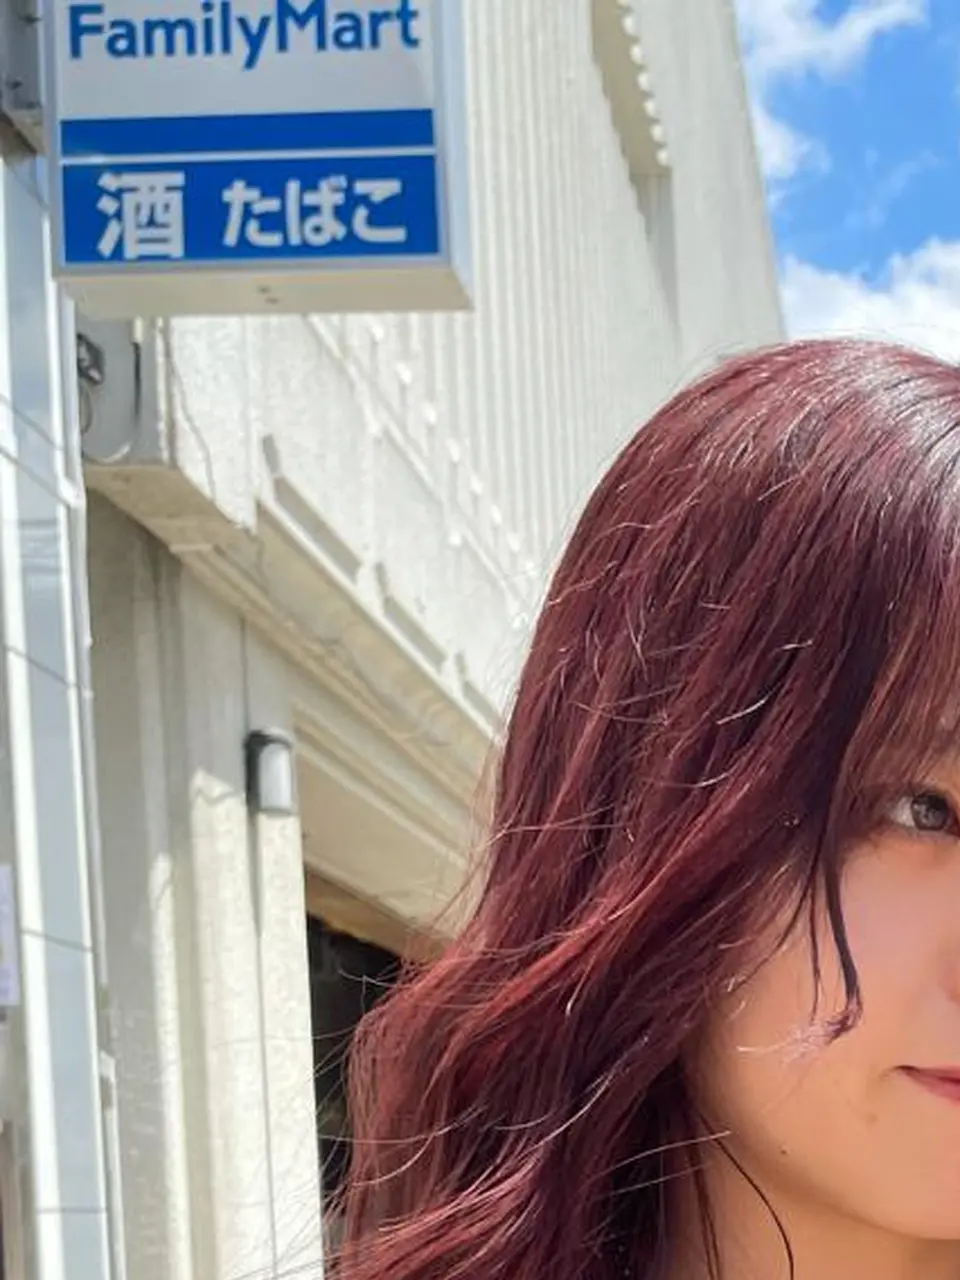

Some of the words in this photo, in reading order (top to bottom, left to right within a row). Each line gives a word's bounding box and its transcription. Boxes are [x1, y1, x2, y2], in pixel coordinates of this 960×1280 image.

[69, 0, 421, 71] FamilyMart
[97, 171, 186, 260] 酒
[222, 175, 407, 248] たばこ
